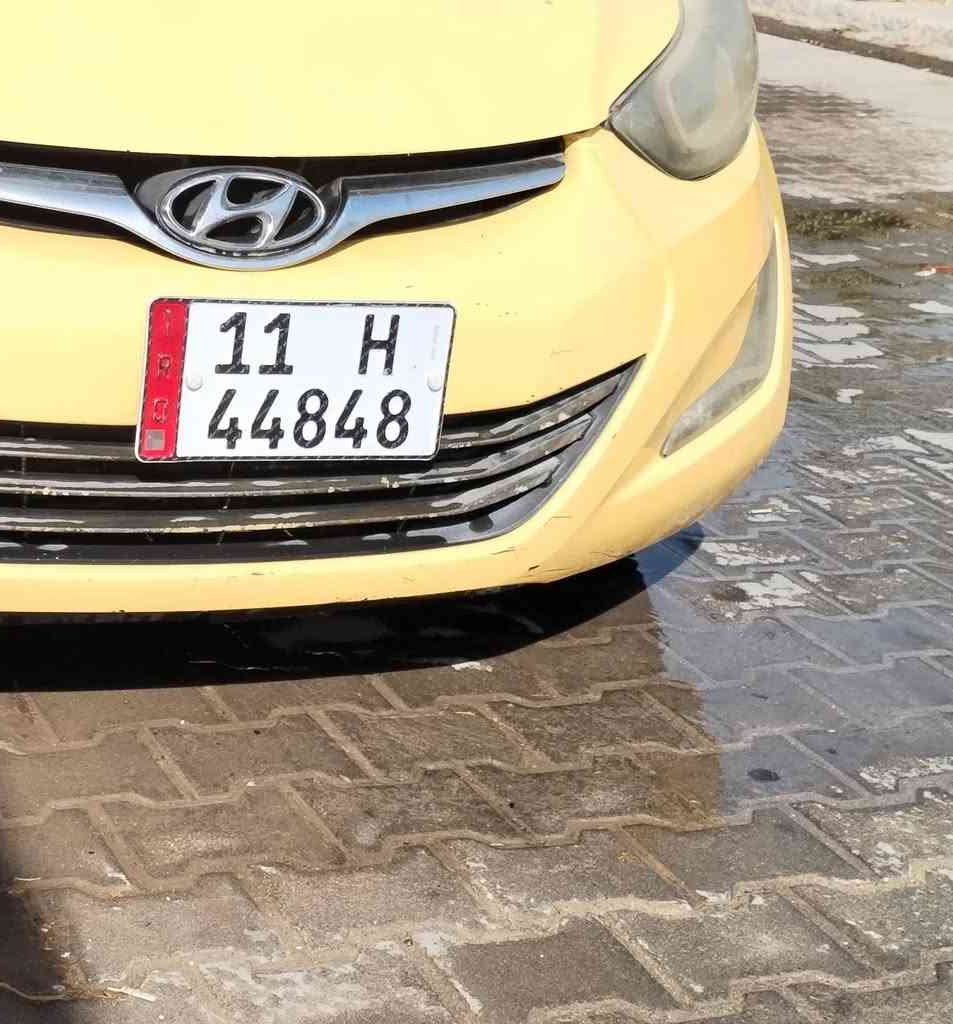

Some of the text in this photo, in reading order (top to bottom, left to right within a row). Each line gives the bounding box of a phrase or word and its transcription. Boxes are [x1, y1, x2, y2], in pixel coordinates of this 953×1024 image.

[214, 311, 294, 375] 11
[358, 313, 400, 375] H
[207, 388, 412, 449] 44848
